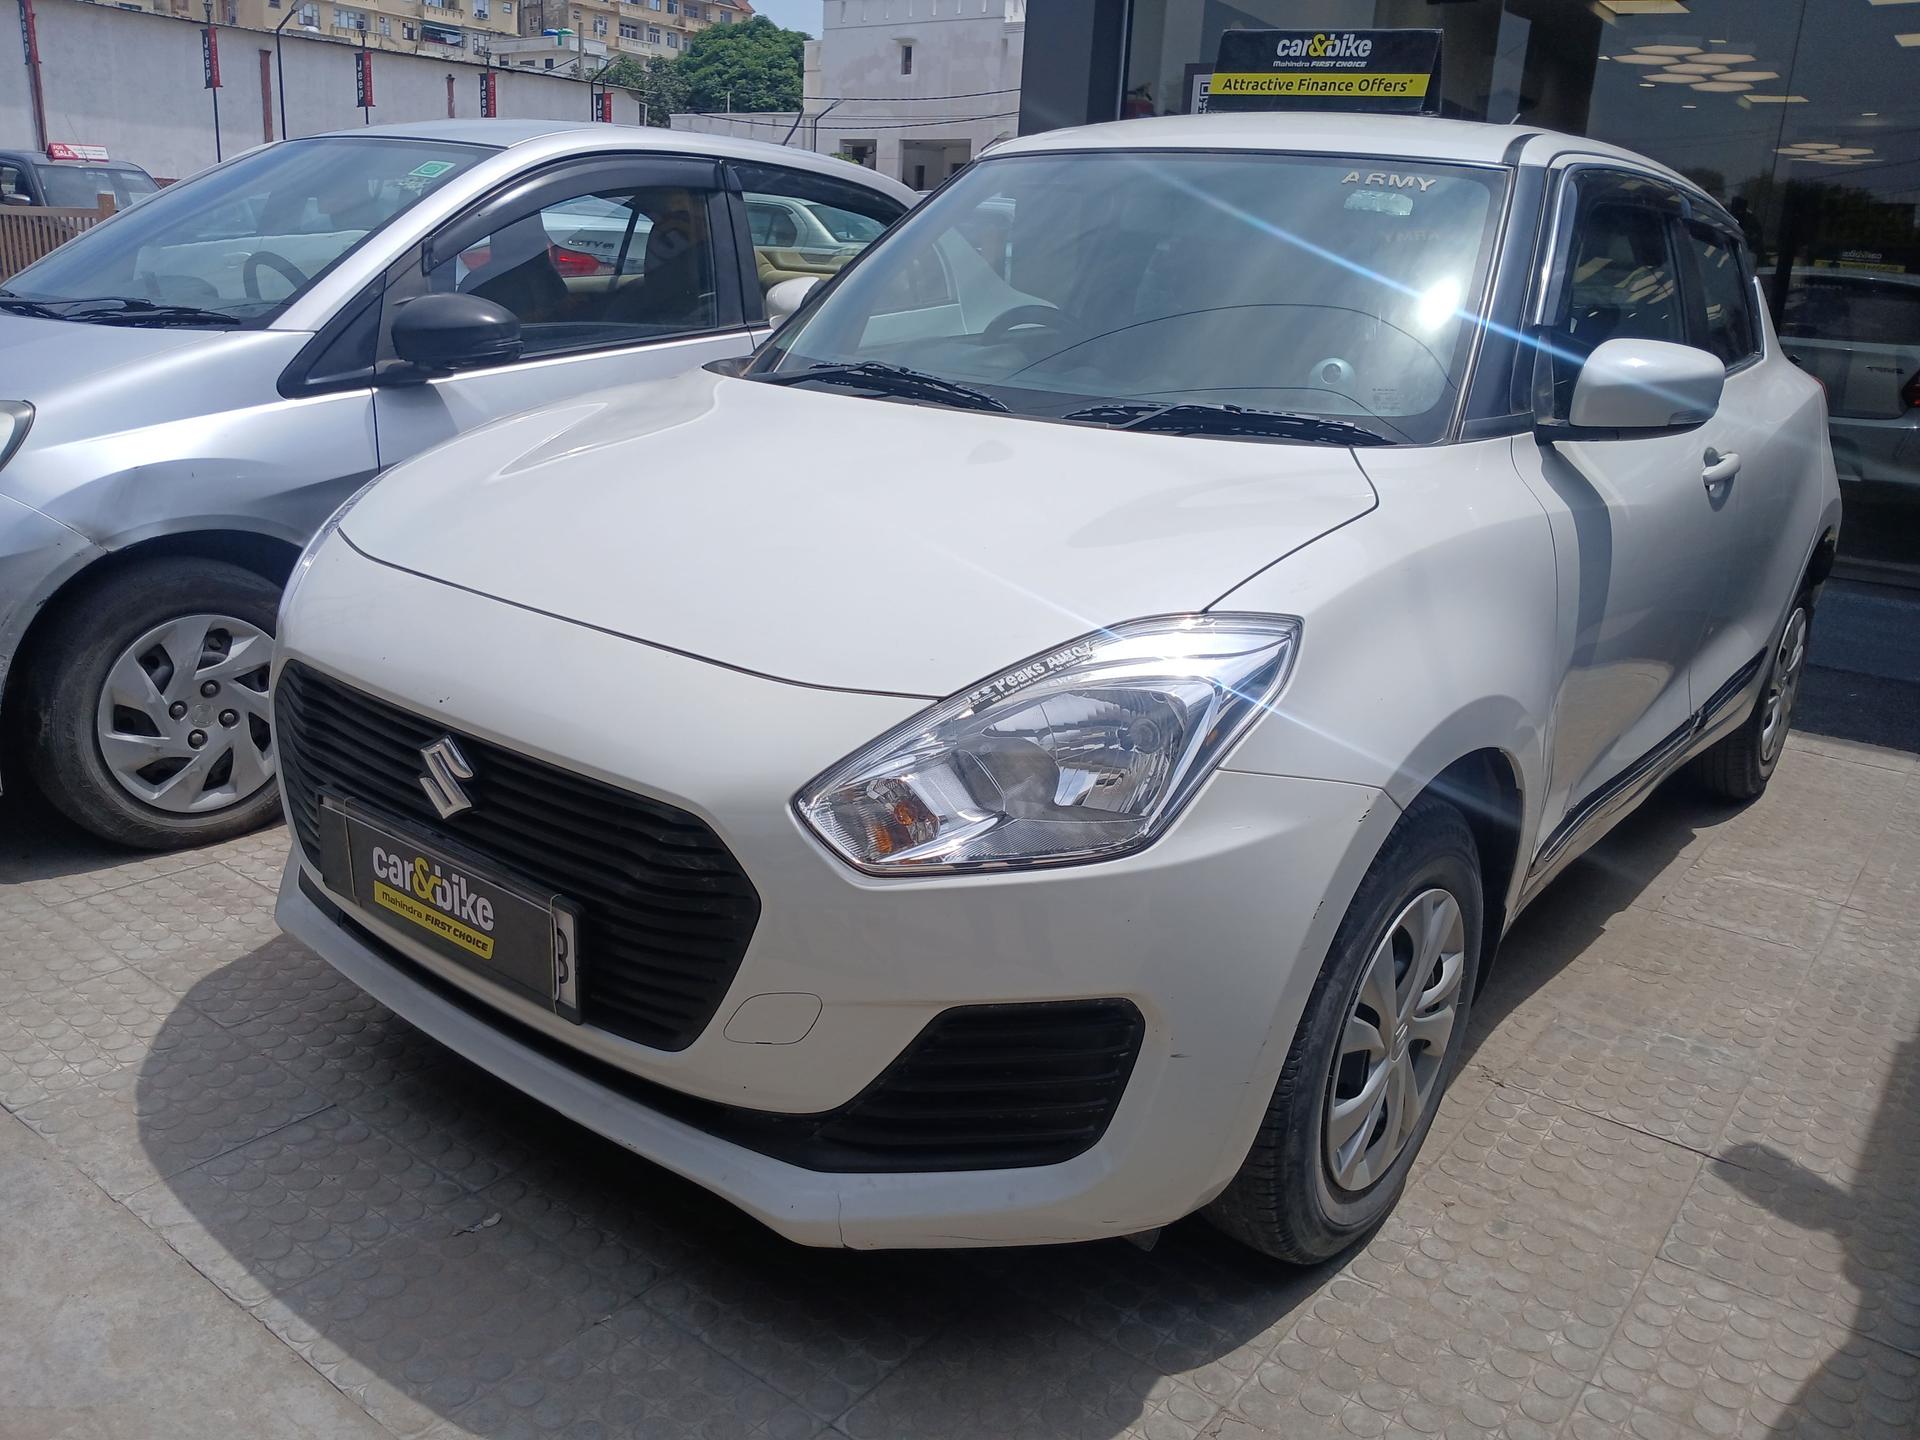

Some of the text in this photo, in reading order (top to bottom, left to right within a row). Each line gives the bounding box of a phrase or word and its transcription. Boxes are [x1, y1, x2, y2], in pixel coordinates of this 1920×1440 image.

[1276, 33, 1373, 58] car&bike
[203, 36, 211, 81] Jeep
[1310, 60, 1336, 68] FIRST
[1336, 60, 1367, 68] CHOICE
[1221, 77, 1294, 92] Attractive
[1297, 77, 1354, 92] Finance
[1341, 171, 1437, 192] ARMY
[372, 846, 495, 931] car&bike
[425, 914, 453, 933] FIRST
[453, 928, 489, 952] CHOICE
